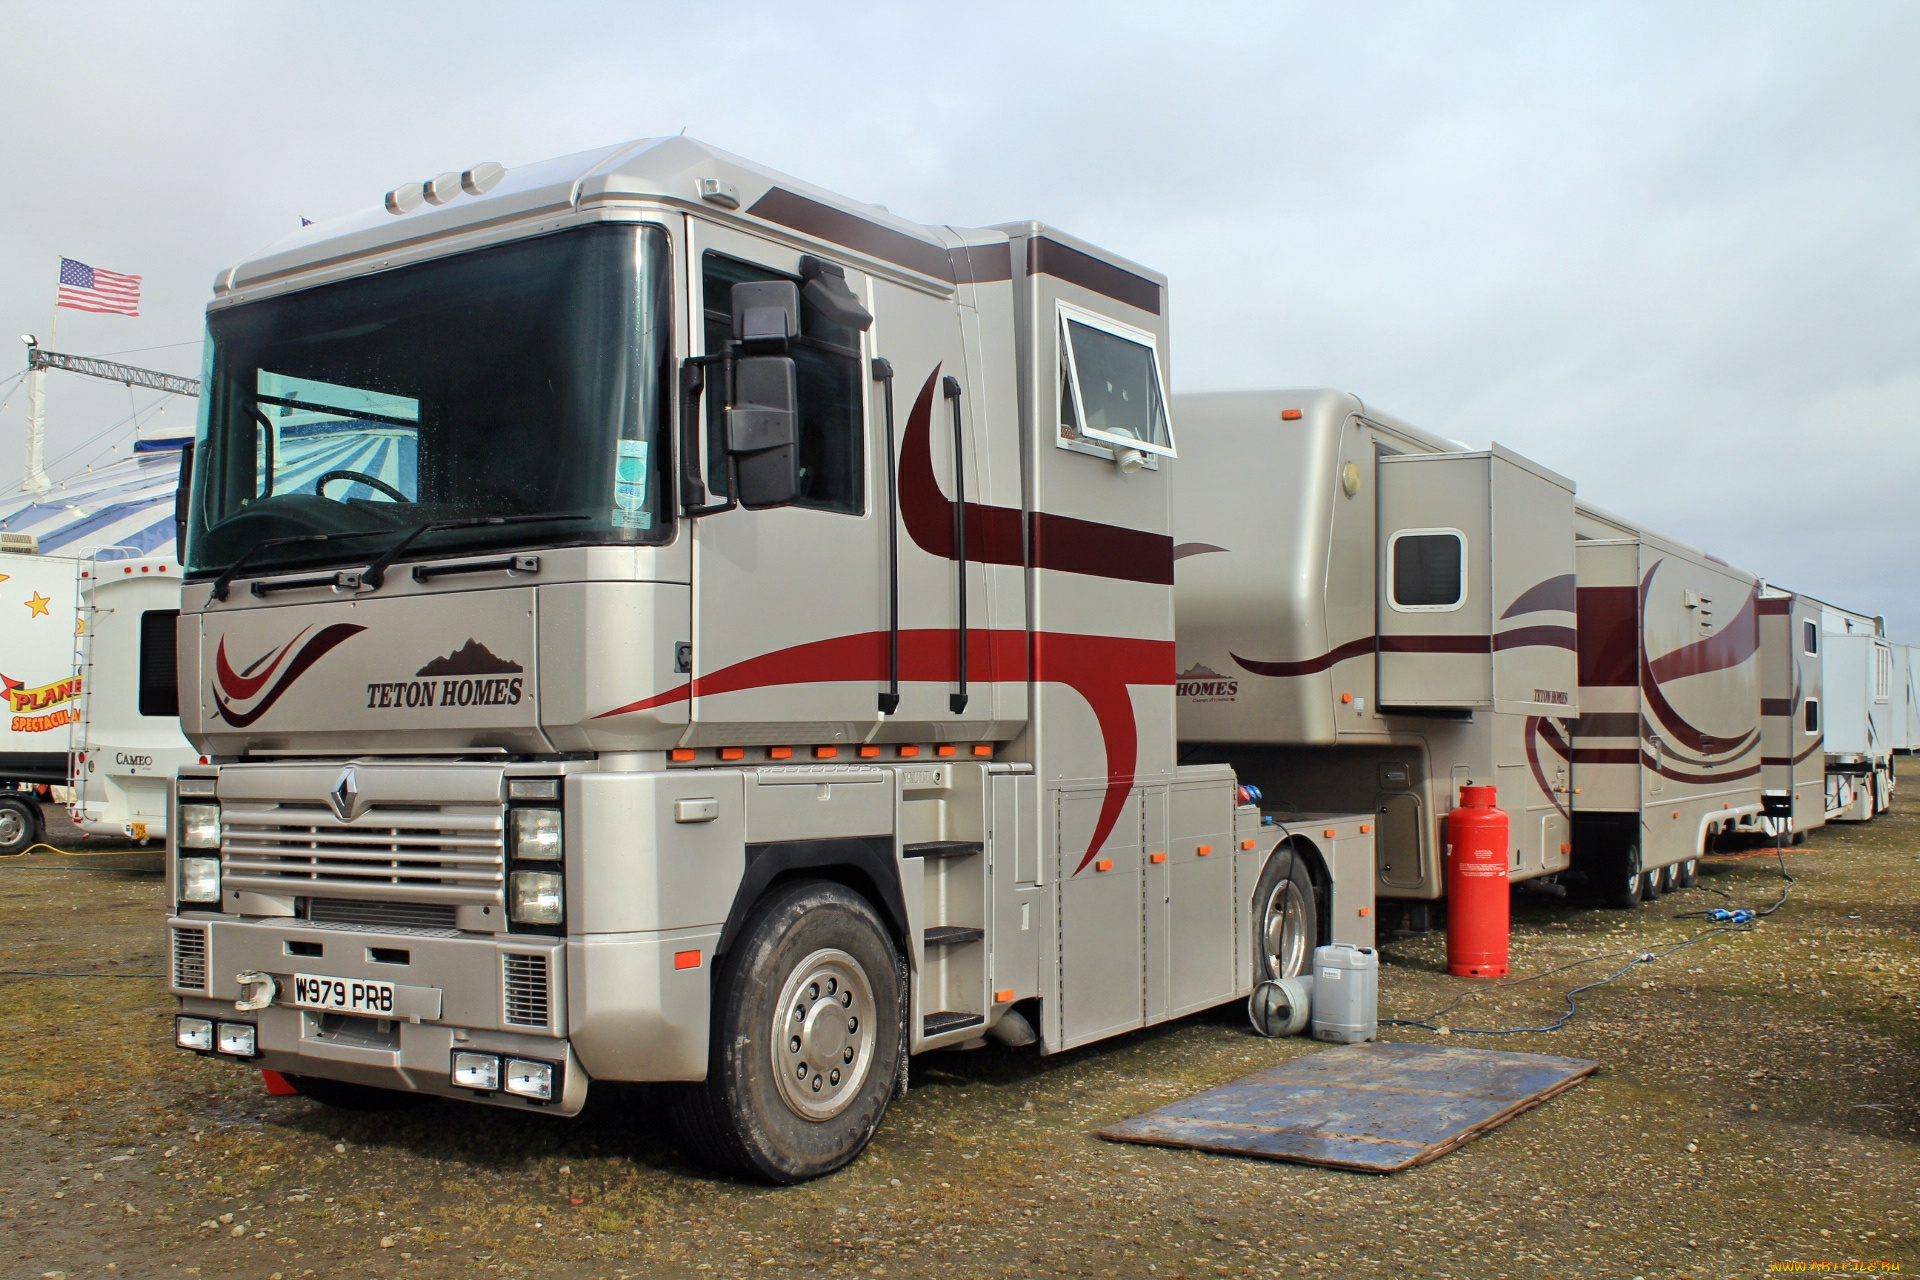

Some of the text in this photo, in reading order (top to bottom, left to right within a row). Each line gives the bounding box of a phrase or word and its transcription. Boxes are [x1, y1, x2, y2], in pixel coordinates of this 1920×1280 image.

[367, 678, 523, 708] TETON HOMES
[1176, 681, 1238, 696] HOMES
[11, 708, 81, 732] SPECTACULA
[296, 977, 393, 1012] W979 PRB
